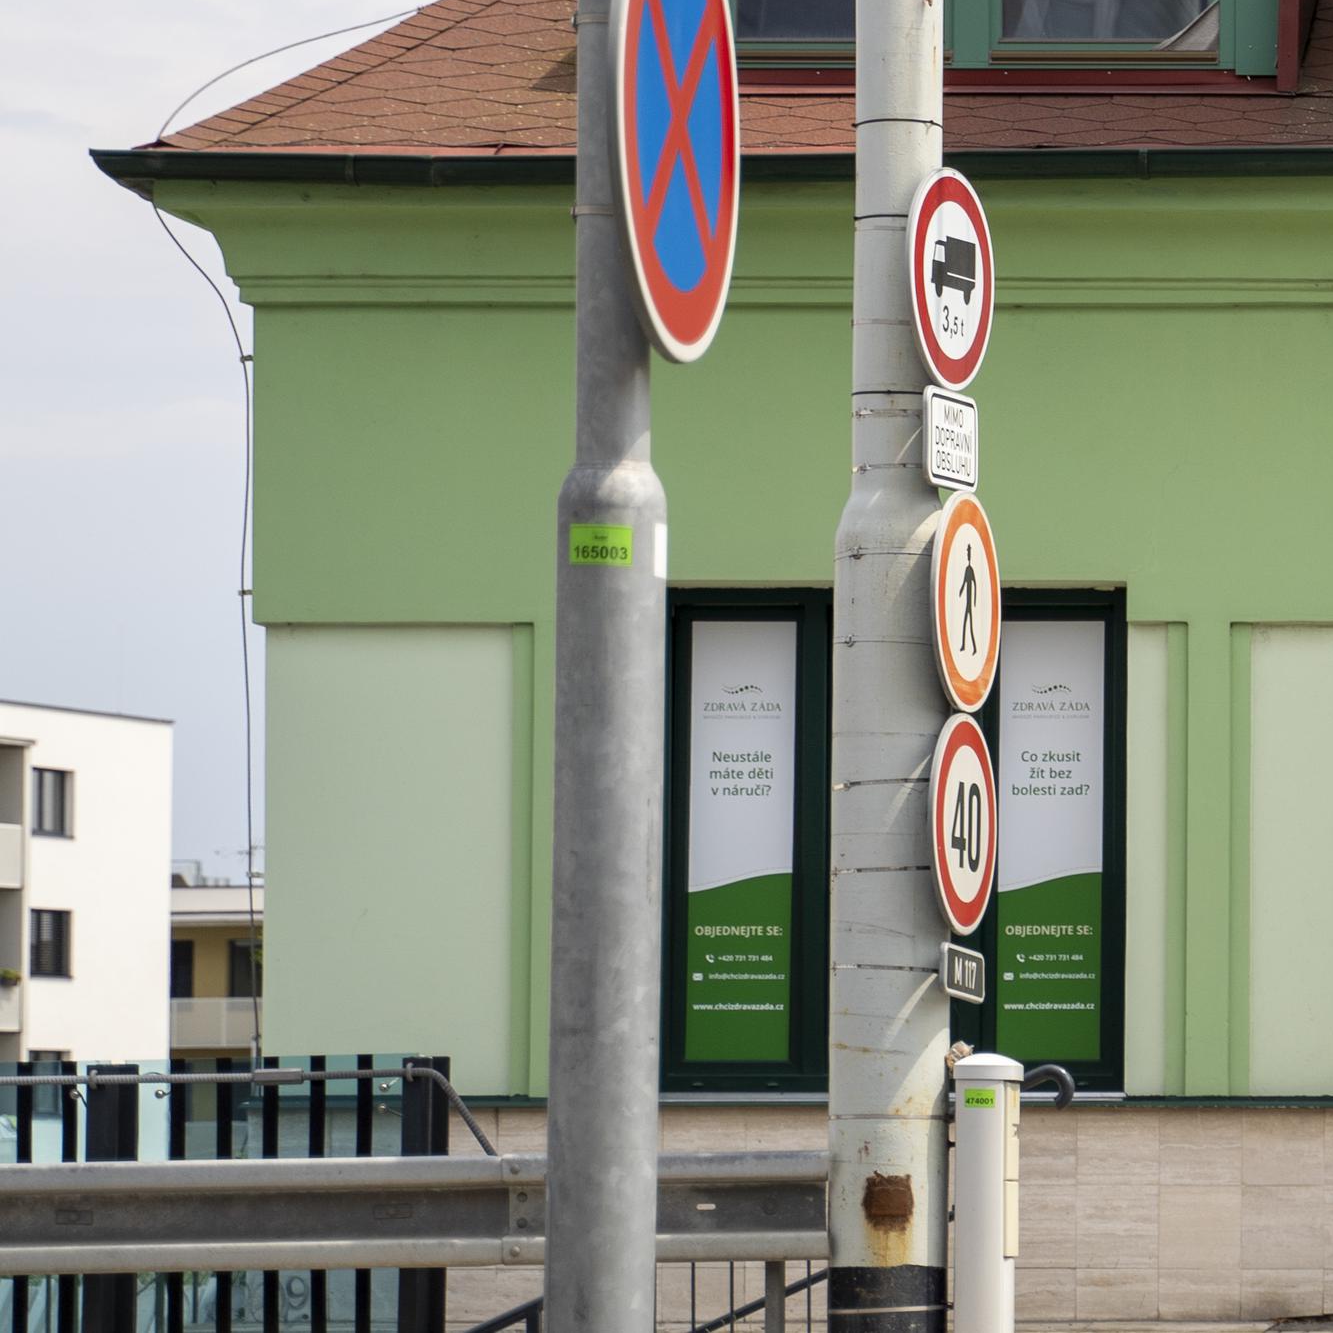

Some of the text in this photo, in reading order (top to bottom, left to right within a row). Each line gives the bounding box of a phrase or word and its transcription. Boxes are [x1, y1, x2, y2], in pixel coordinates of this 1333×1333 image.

[942, 305, 958, 339] 3,5
[944, 405, 964, 427] MIMO
[936, 425, 972, 455] DOPRAVNÍ
[936, 450, 972, 477] OBSLUHU
[574, 545, 628, 560] 165003
[704, 701, 782, 711] ZDRAVÁ ZÁDA
[1012, 701, 1090, 711] ZDRAVÁ ZÁDA
[712, 751, 772, 762] Neustále
[1021, 751, 1081, 762] Co zkusit
[710, 767, 774, 779] máte děti
[1029, 767, 1072, 779] žít bez
[711, 784, 772, 796] v náručí?
[1012, 784, 1090, 795] bolesti zad?
[951, 781, 982, 873] 40
[695, 926, 783, 938] OBJEDNEJTE SE:
[1005, 925, 1093, 937] OBJEDNEJTE SE:
[954, 956, 962, 985] M
